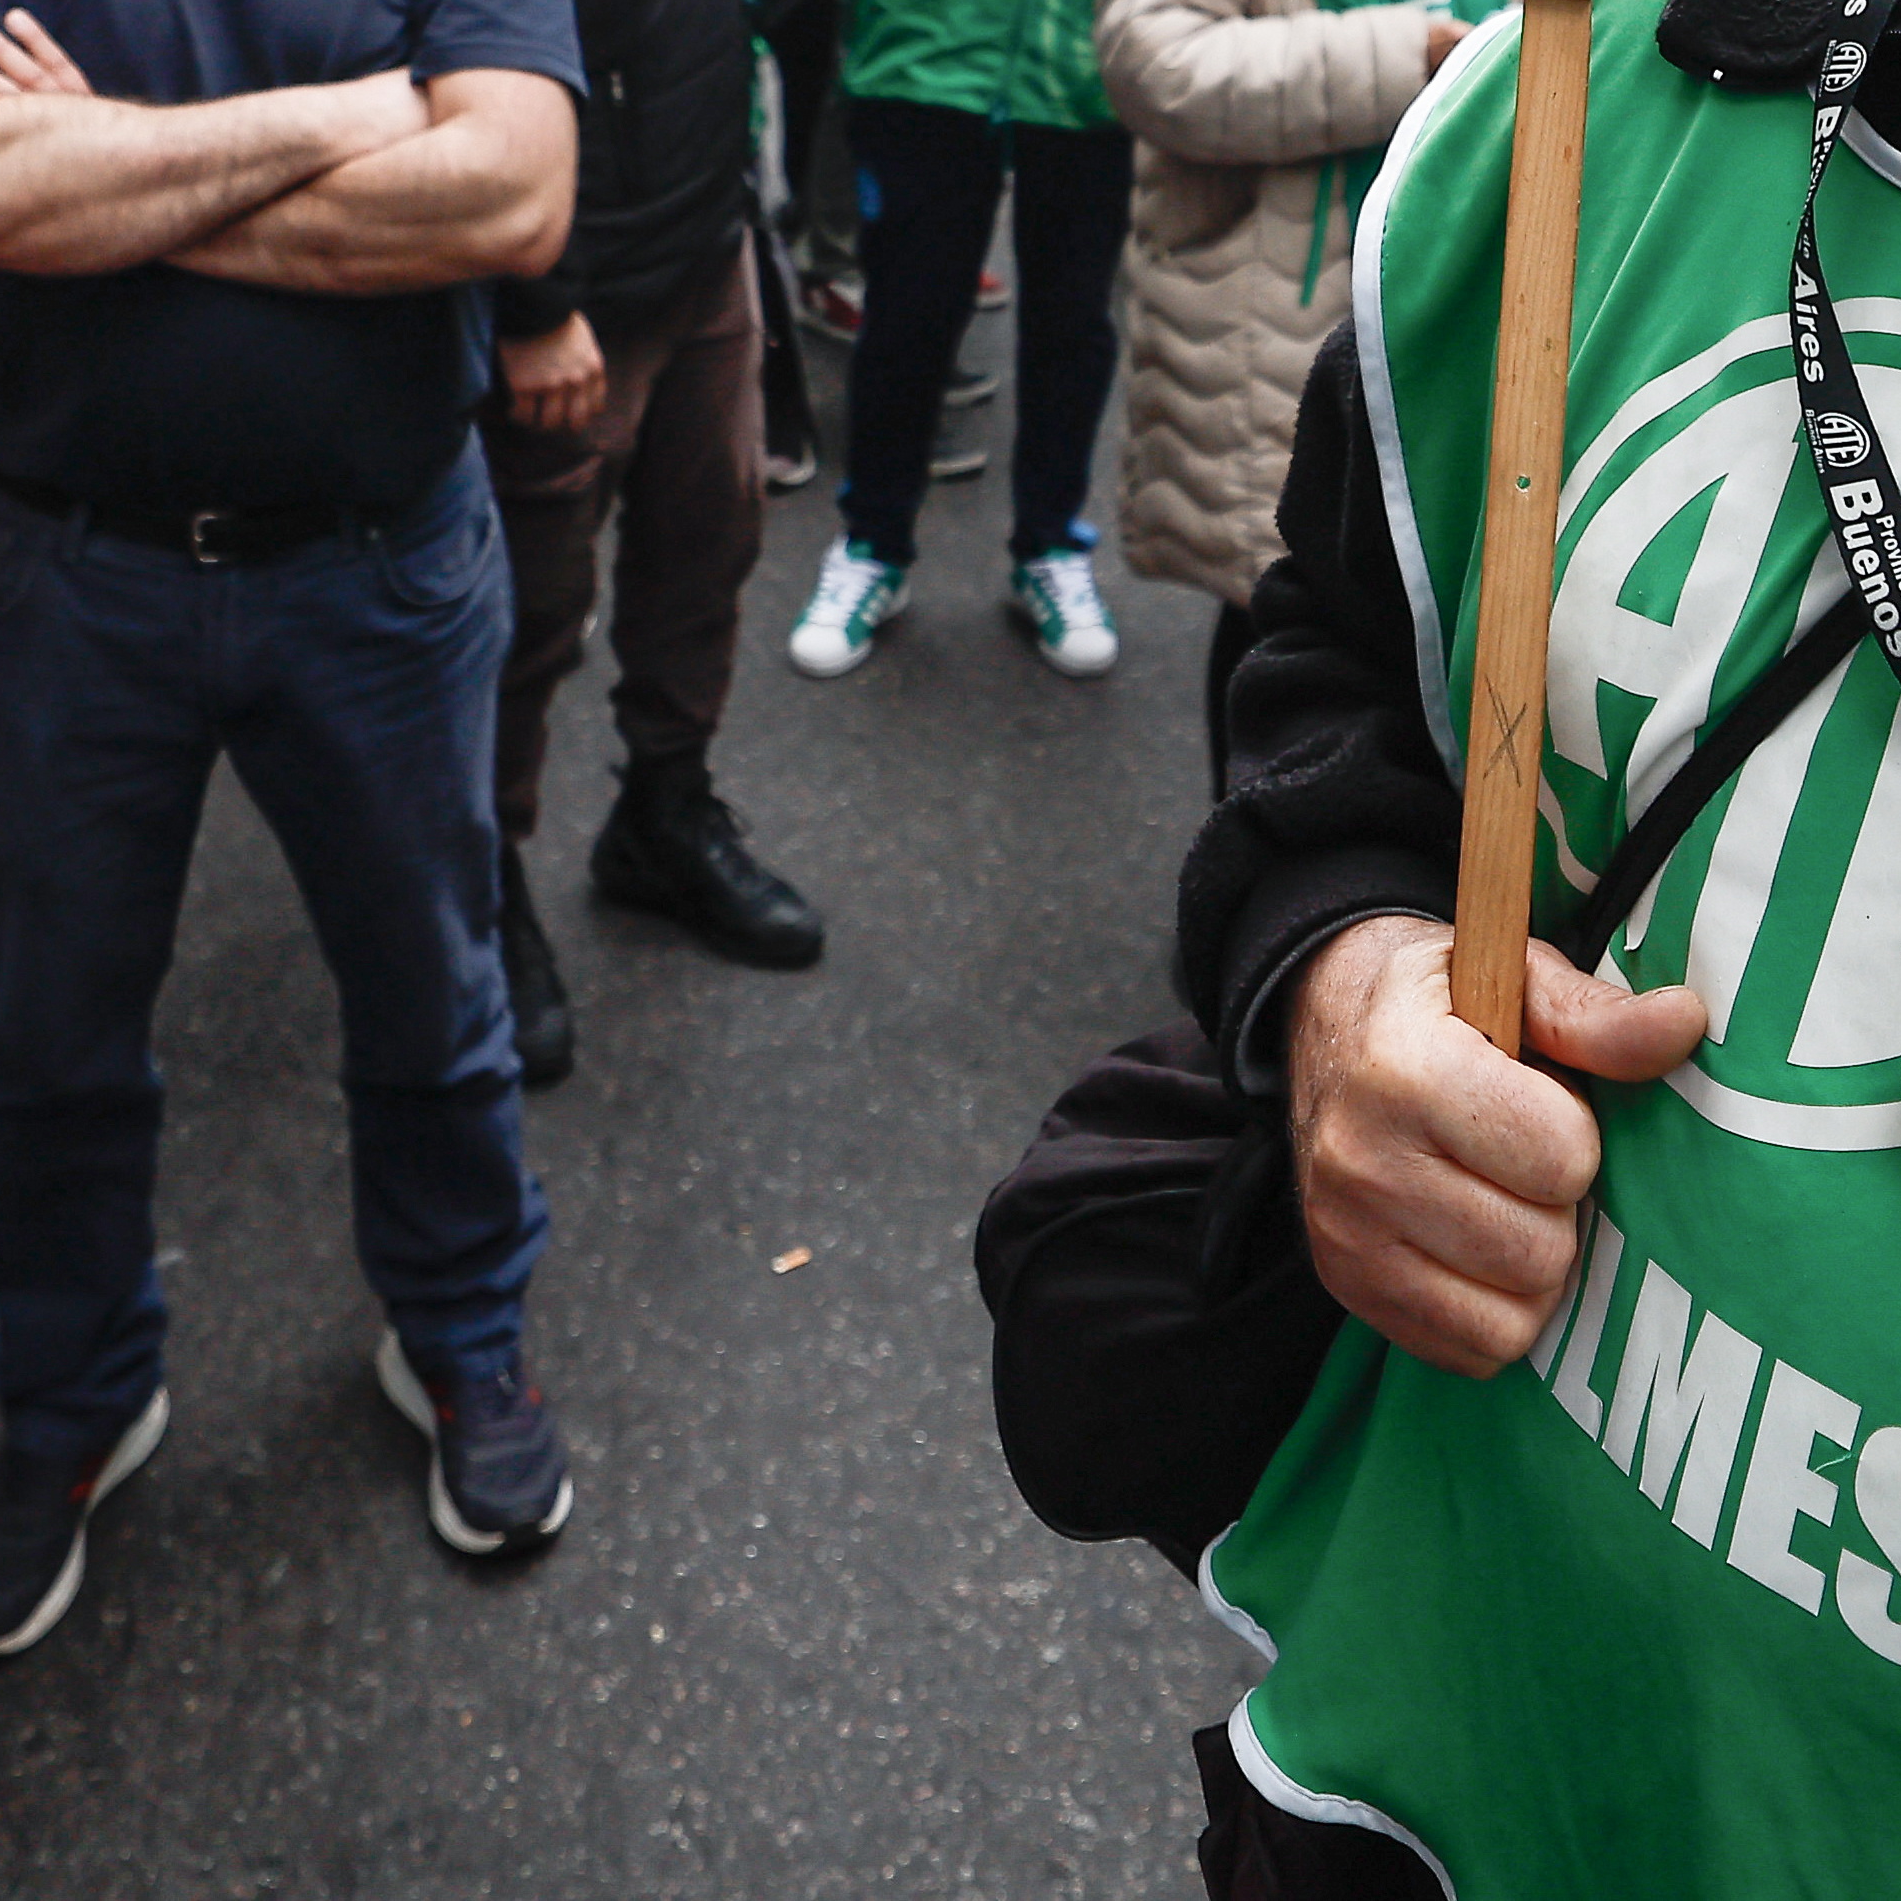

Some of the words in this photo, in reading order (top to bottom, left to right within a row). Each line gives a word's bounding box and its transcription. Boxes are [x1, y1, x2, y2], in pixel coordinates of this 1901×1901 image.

[1824, 44, 1863, 88] ATE
[1793, 260, 1825, 384] Aires
[1821, 413, 1866, 466] ATE
